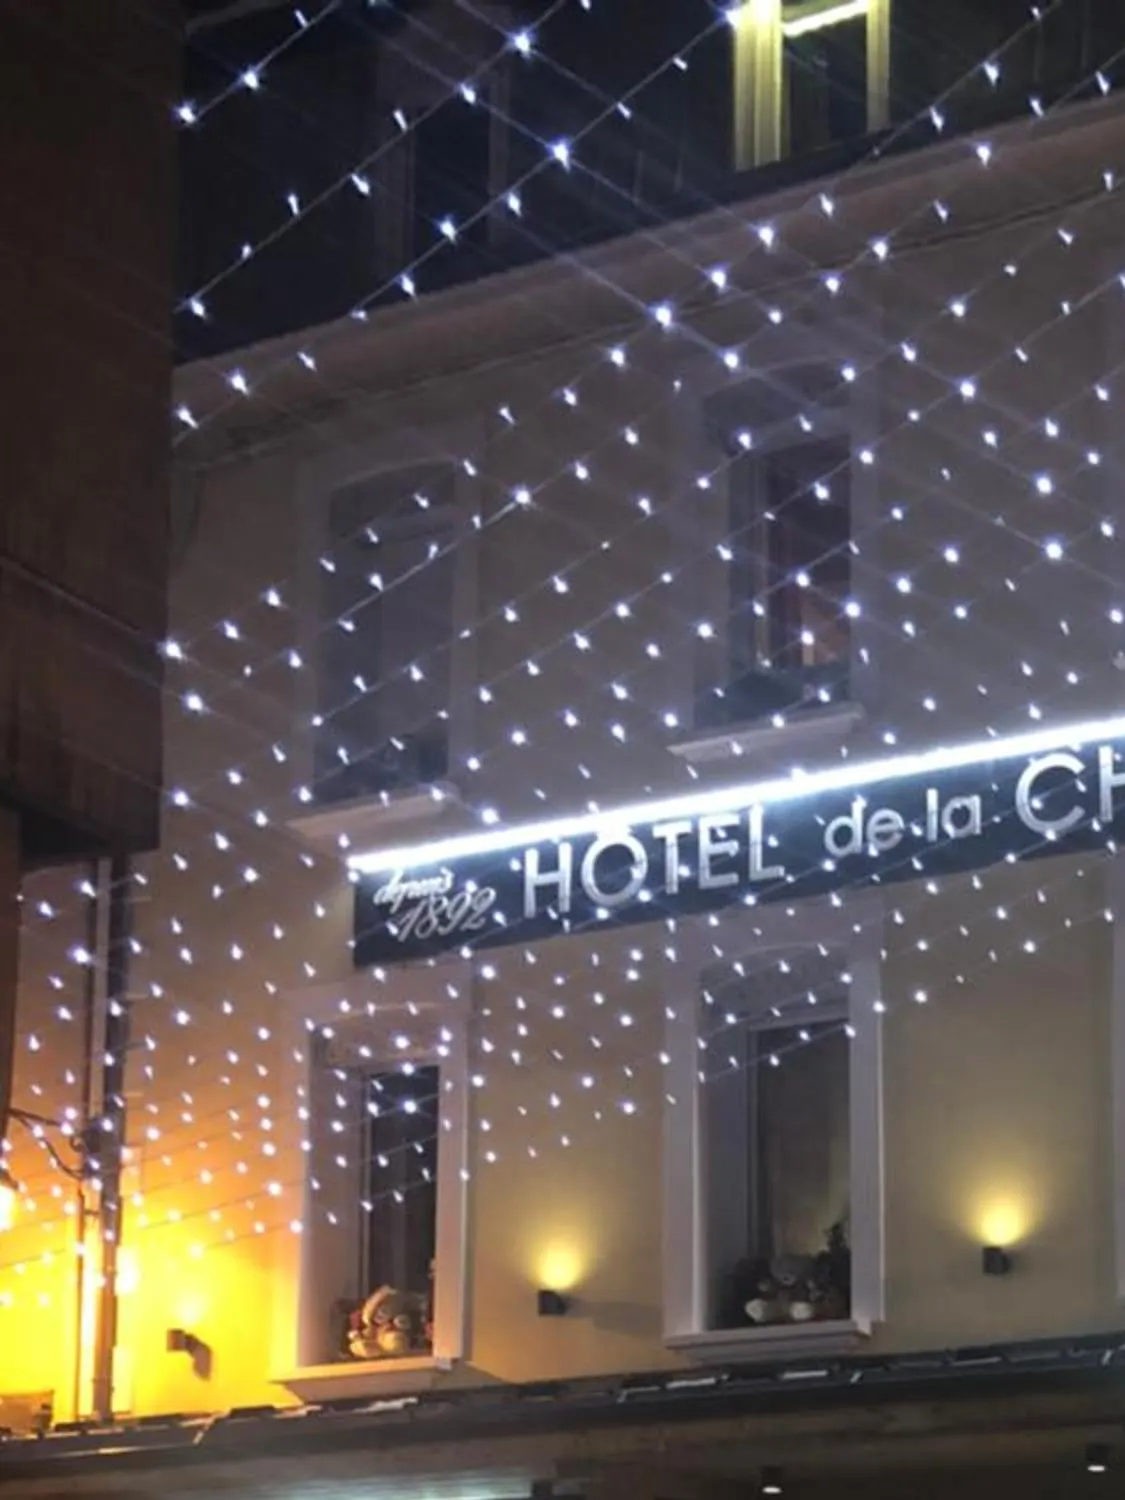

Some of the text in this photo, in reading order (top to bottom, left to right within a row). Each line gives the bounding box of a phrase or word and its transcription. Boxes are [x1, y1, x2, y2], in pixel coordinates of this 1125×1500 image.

[824, 795, 904, 857] de
[926, 788, 982, 841] la
[398, 887, 497, 942] 1892
